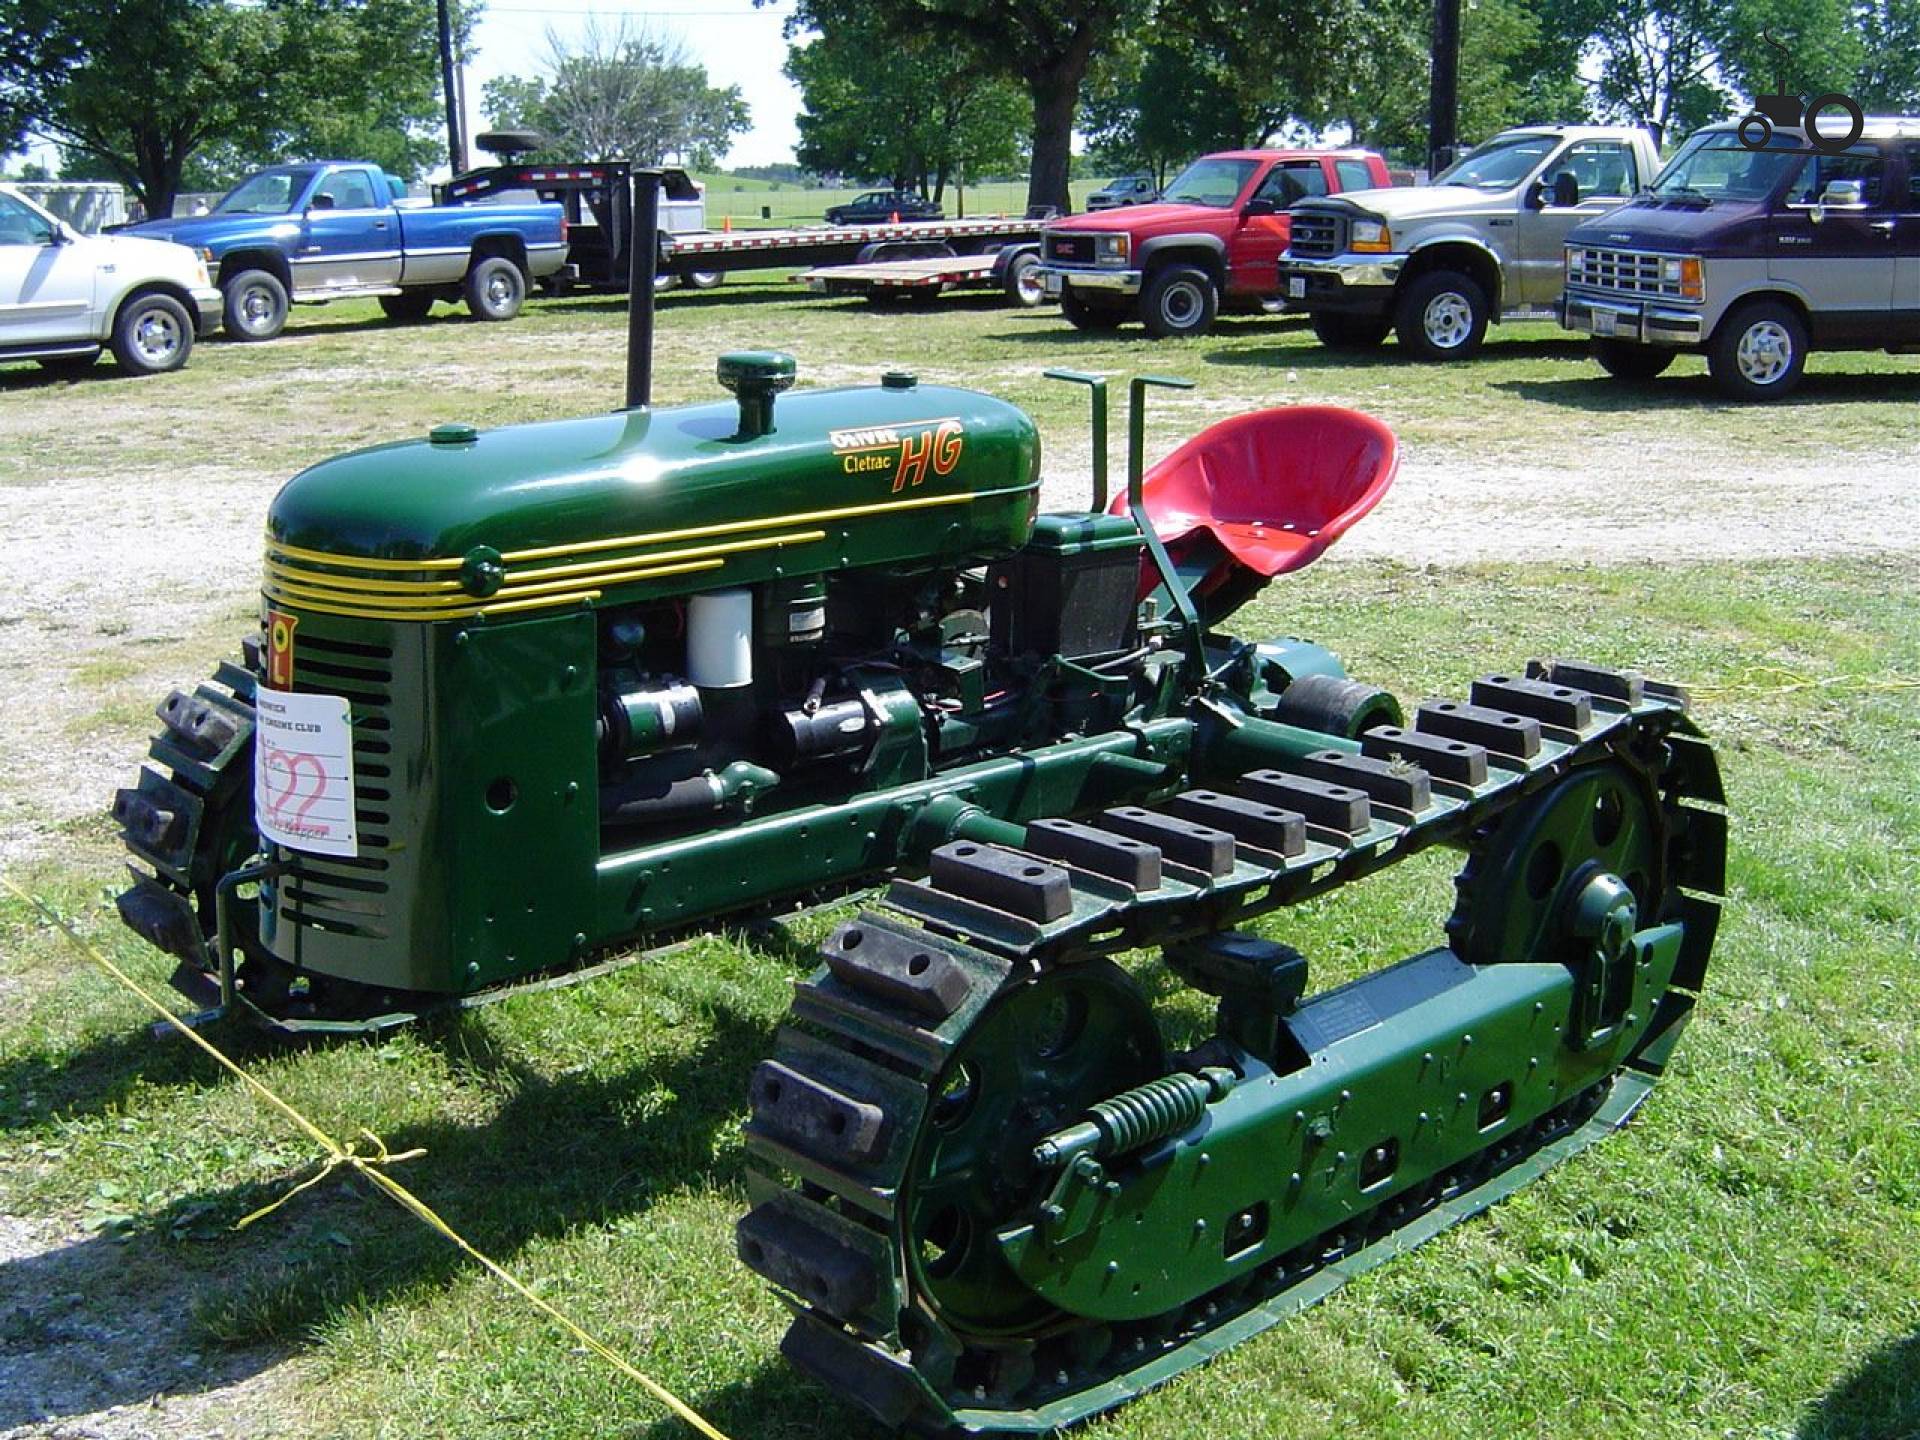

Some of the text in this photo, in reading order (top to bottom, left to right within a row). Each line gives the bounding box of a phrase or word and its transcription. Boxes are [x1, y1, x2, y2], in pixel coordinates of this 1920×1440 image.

[844, 456, 891, 473] Cletrac
[892, 421, 963, 493] HG
[295, 722, 321, 733] CLUB
